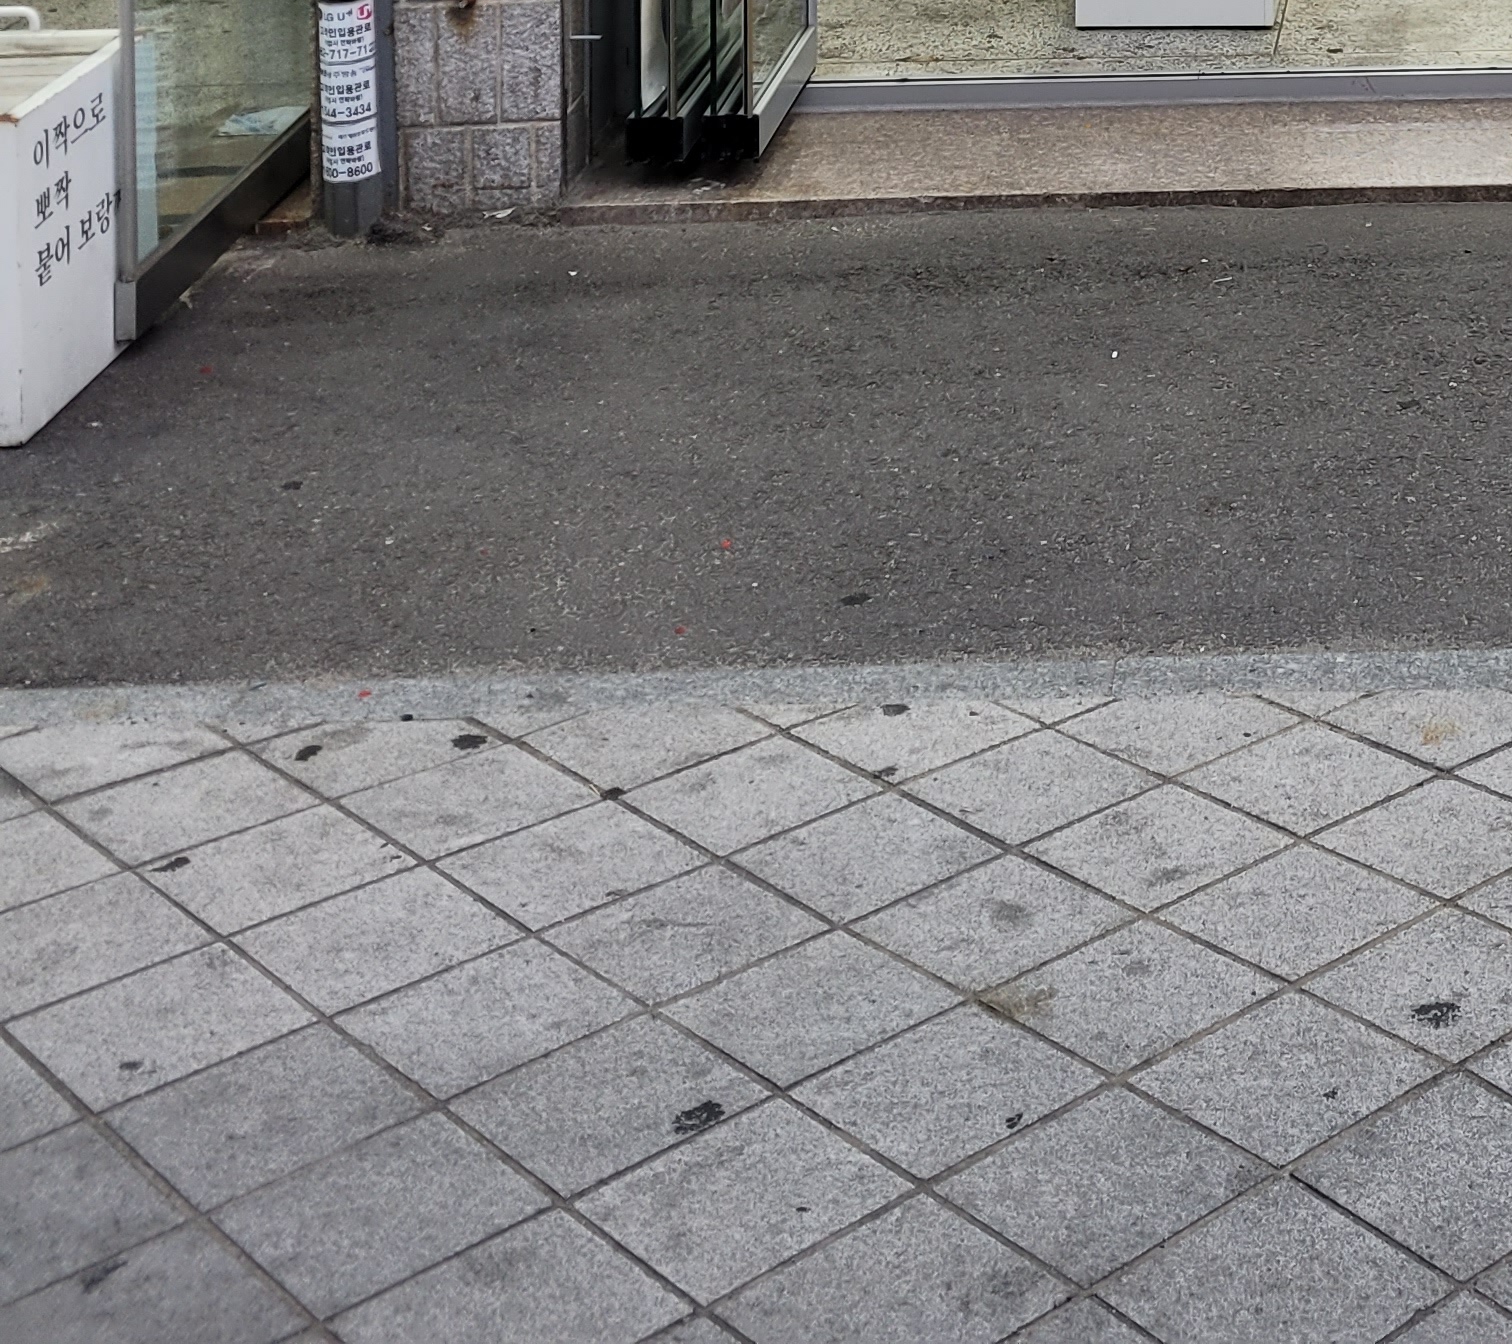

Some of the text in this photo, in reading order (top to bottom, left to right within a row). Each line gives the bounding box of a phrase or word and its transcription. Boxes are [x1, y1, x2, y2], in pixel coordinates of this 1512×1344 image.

[32, 92, 107, 170] 이짝으로
[34, 170, 73, 231] 뽀짝
[35, 234, 73, 288] 붙어
